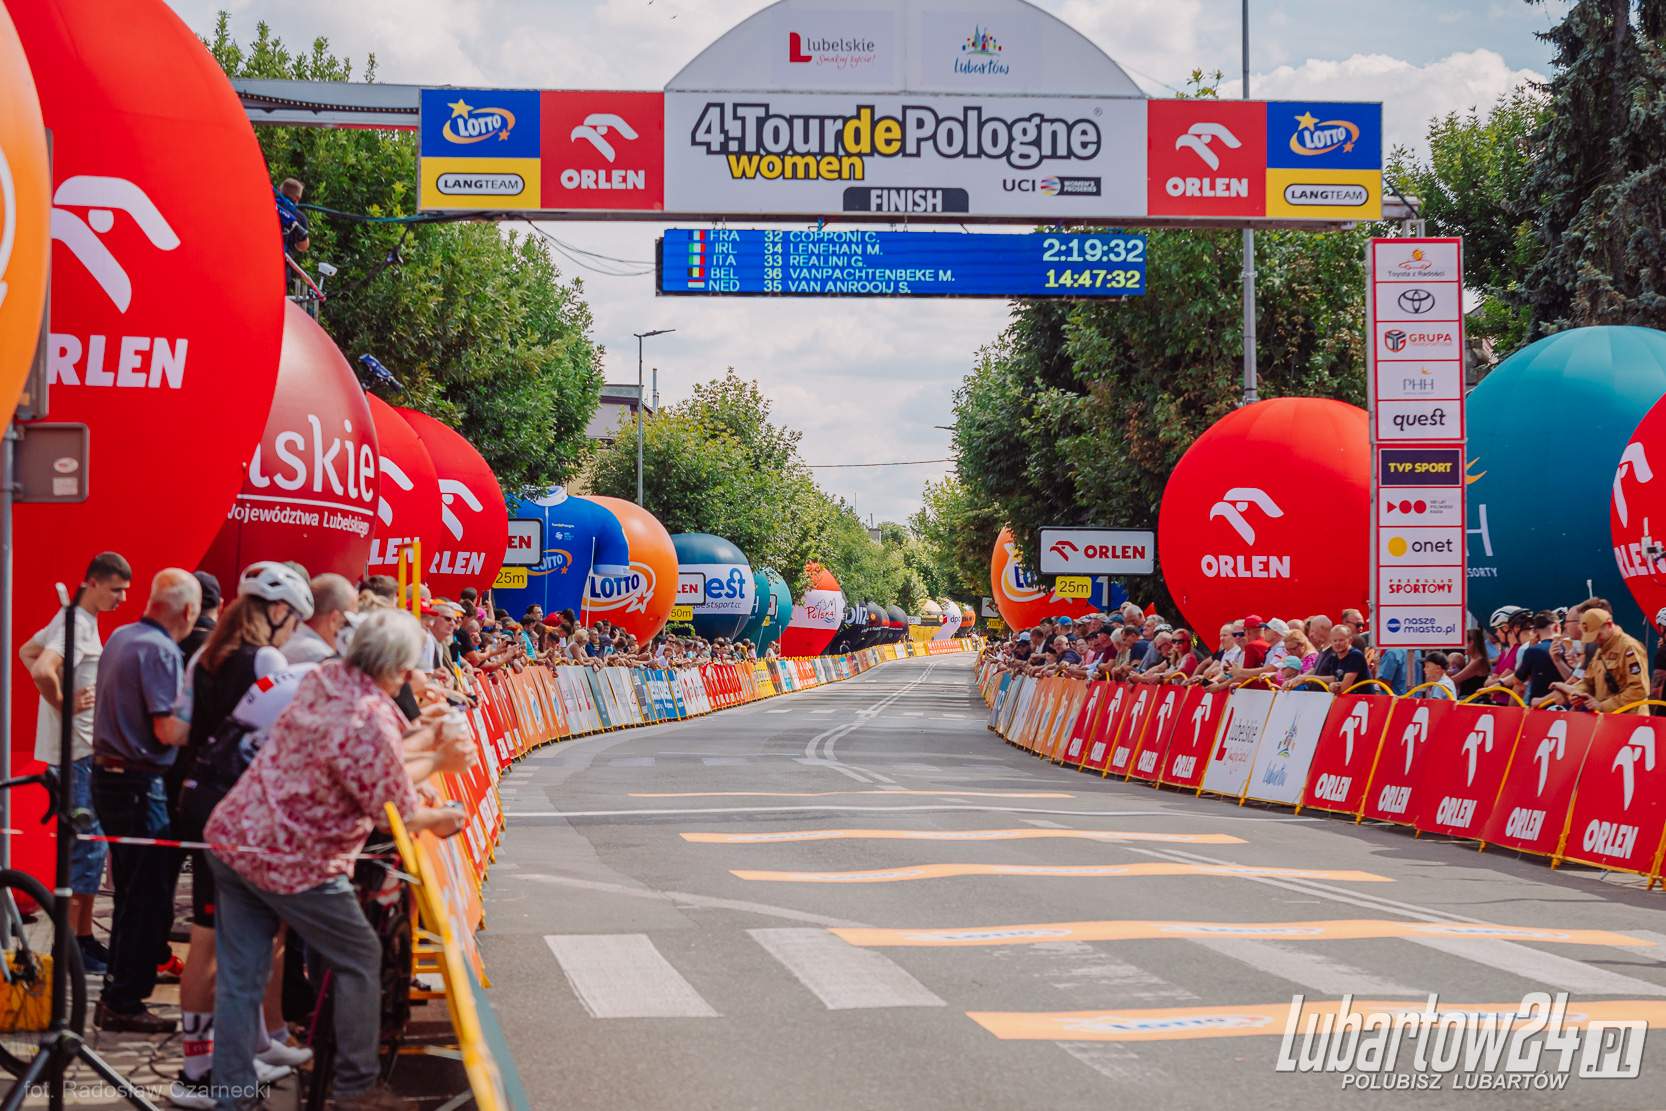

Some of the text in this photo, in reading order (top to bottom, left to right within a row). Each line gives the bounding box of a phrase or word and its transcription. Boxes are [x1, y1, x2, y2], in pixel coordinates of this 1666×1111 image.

[457, 115, 502, 138] LOTTO
[1303, 127, 1346, 148] LOTTO
[727, 155, 865, 180] women
[560, 169, 646, 190] ORLEN
[1003, 179, 1036, 193] UCI
[1165, 176, 1249, 198] ORLEN
[870, 188, 942, 213] FINISH
[710, 231, 740, 241] FRA
[764, 231, 783, 242] 32
[790, 231, 861, 242] COPPONI
[715, 243, 883, 255] IRL 34 LENEHAN M.
[1042, 239, 1144, 262] 2:19:32
[713, 255, 867, 267] ITA 33 REALINI G.
[711, 268, 955, 281] BEL 36 VANPACHTENBEKE M.
[1045, 269, 1140, 288] 14:47:32
[709, 280, 911, 293] NED 35 VAN ANROOIJ S.
[1409, 333, 1452, 343] GRUPA
[1403, 378, 1434, 391] PHH
[1393, 408, 1446, 431] quest
[1388, 462, 1452, 473] TVP SPORT
[1084, 545, 1145, 559] ORLEN
[1411, 538, 1453, 553] onet
[1201, 554, 1290, 578] ORLEN
[589, 574, 640, 598] LOTTO
[1060, 580, 1088, 593] 25m
[1389, 584, 1454, 594] SPORTOWY
[671, 609, 691, 617] 50m
[1404, 617, 1436, 625] nasze
[1404, 624, 1456, 635] miasto.pl
[1314, 773, 1353, 803] ORLEN
[1377, 784, 1412, 815] ORLEN
[1436, 795, 1477, 828] ORLEN
[1505, 807, 1546, 841] ORLEN
[1583, 819, 1639, 860] ORLEN
